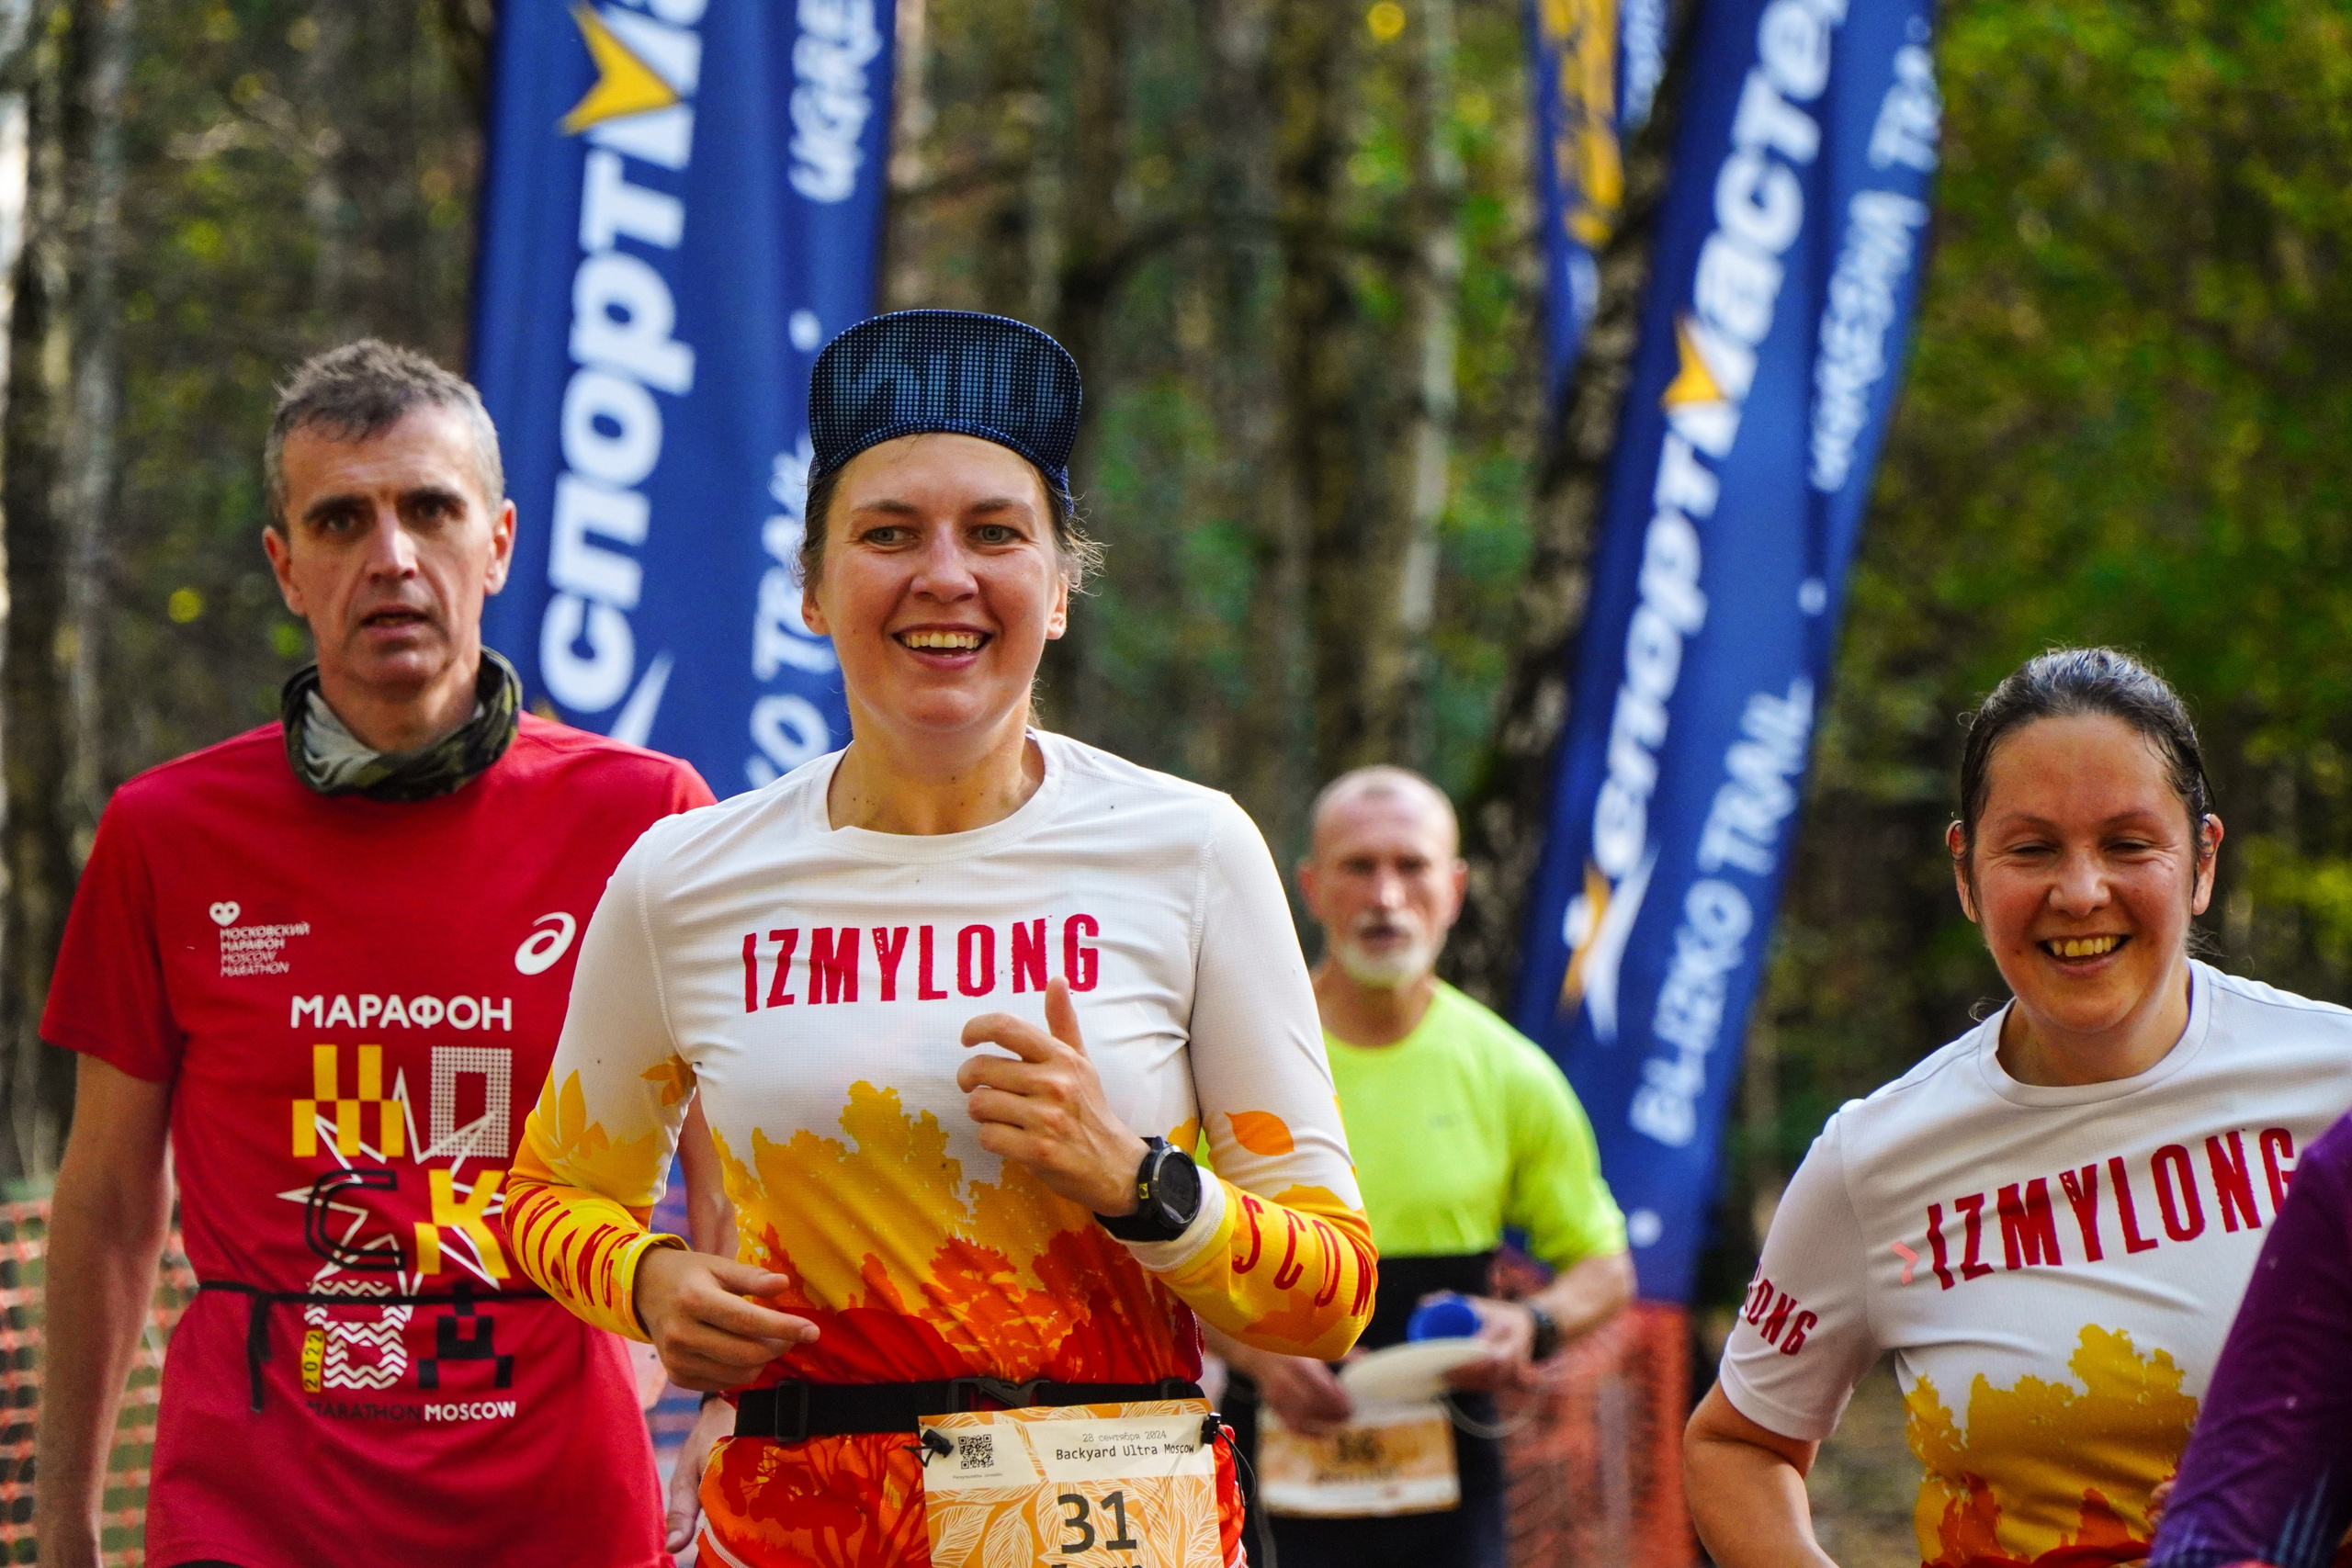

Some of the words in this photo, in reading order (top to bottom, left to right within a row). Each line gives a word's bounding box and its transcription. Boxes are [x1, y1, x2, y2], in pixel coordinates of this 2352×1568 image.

[1697, 675, 1815, 876] TRAIL
[742, 913, 1100, 1013] IZMYLONG
[290, 994, 512, 1031] МАРАФОН
[302, 1332, 324, 1391] 2022
[424, 1400, 517, 1422] MOSCOW
[1056, 1445, 1116, 1461] Backyard
[1123, 1443, 1159, 1457] Ultra
[1164, 1442, 1195, 1455] Moscow
[1082, 1433, 1094, 1443] 28
[1099, 1431, 1141, 1442] сентября
[1144, 1429, 1168, 1440] 2024
[1057, 1490, 1137, 1554] 31
